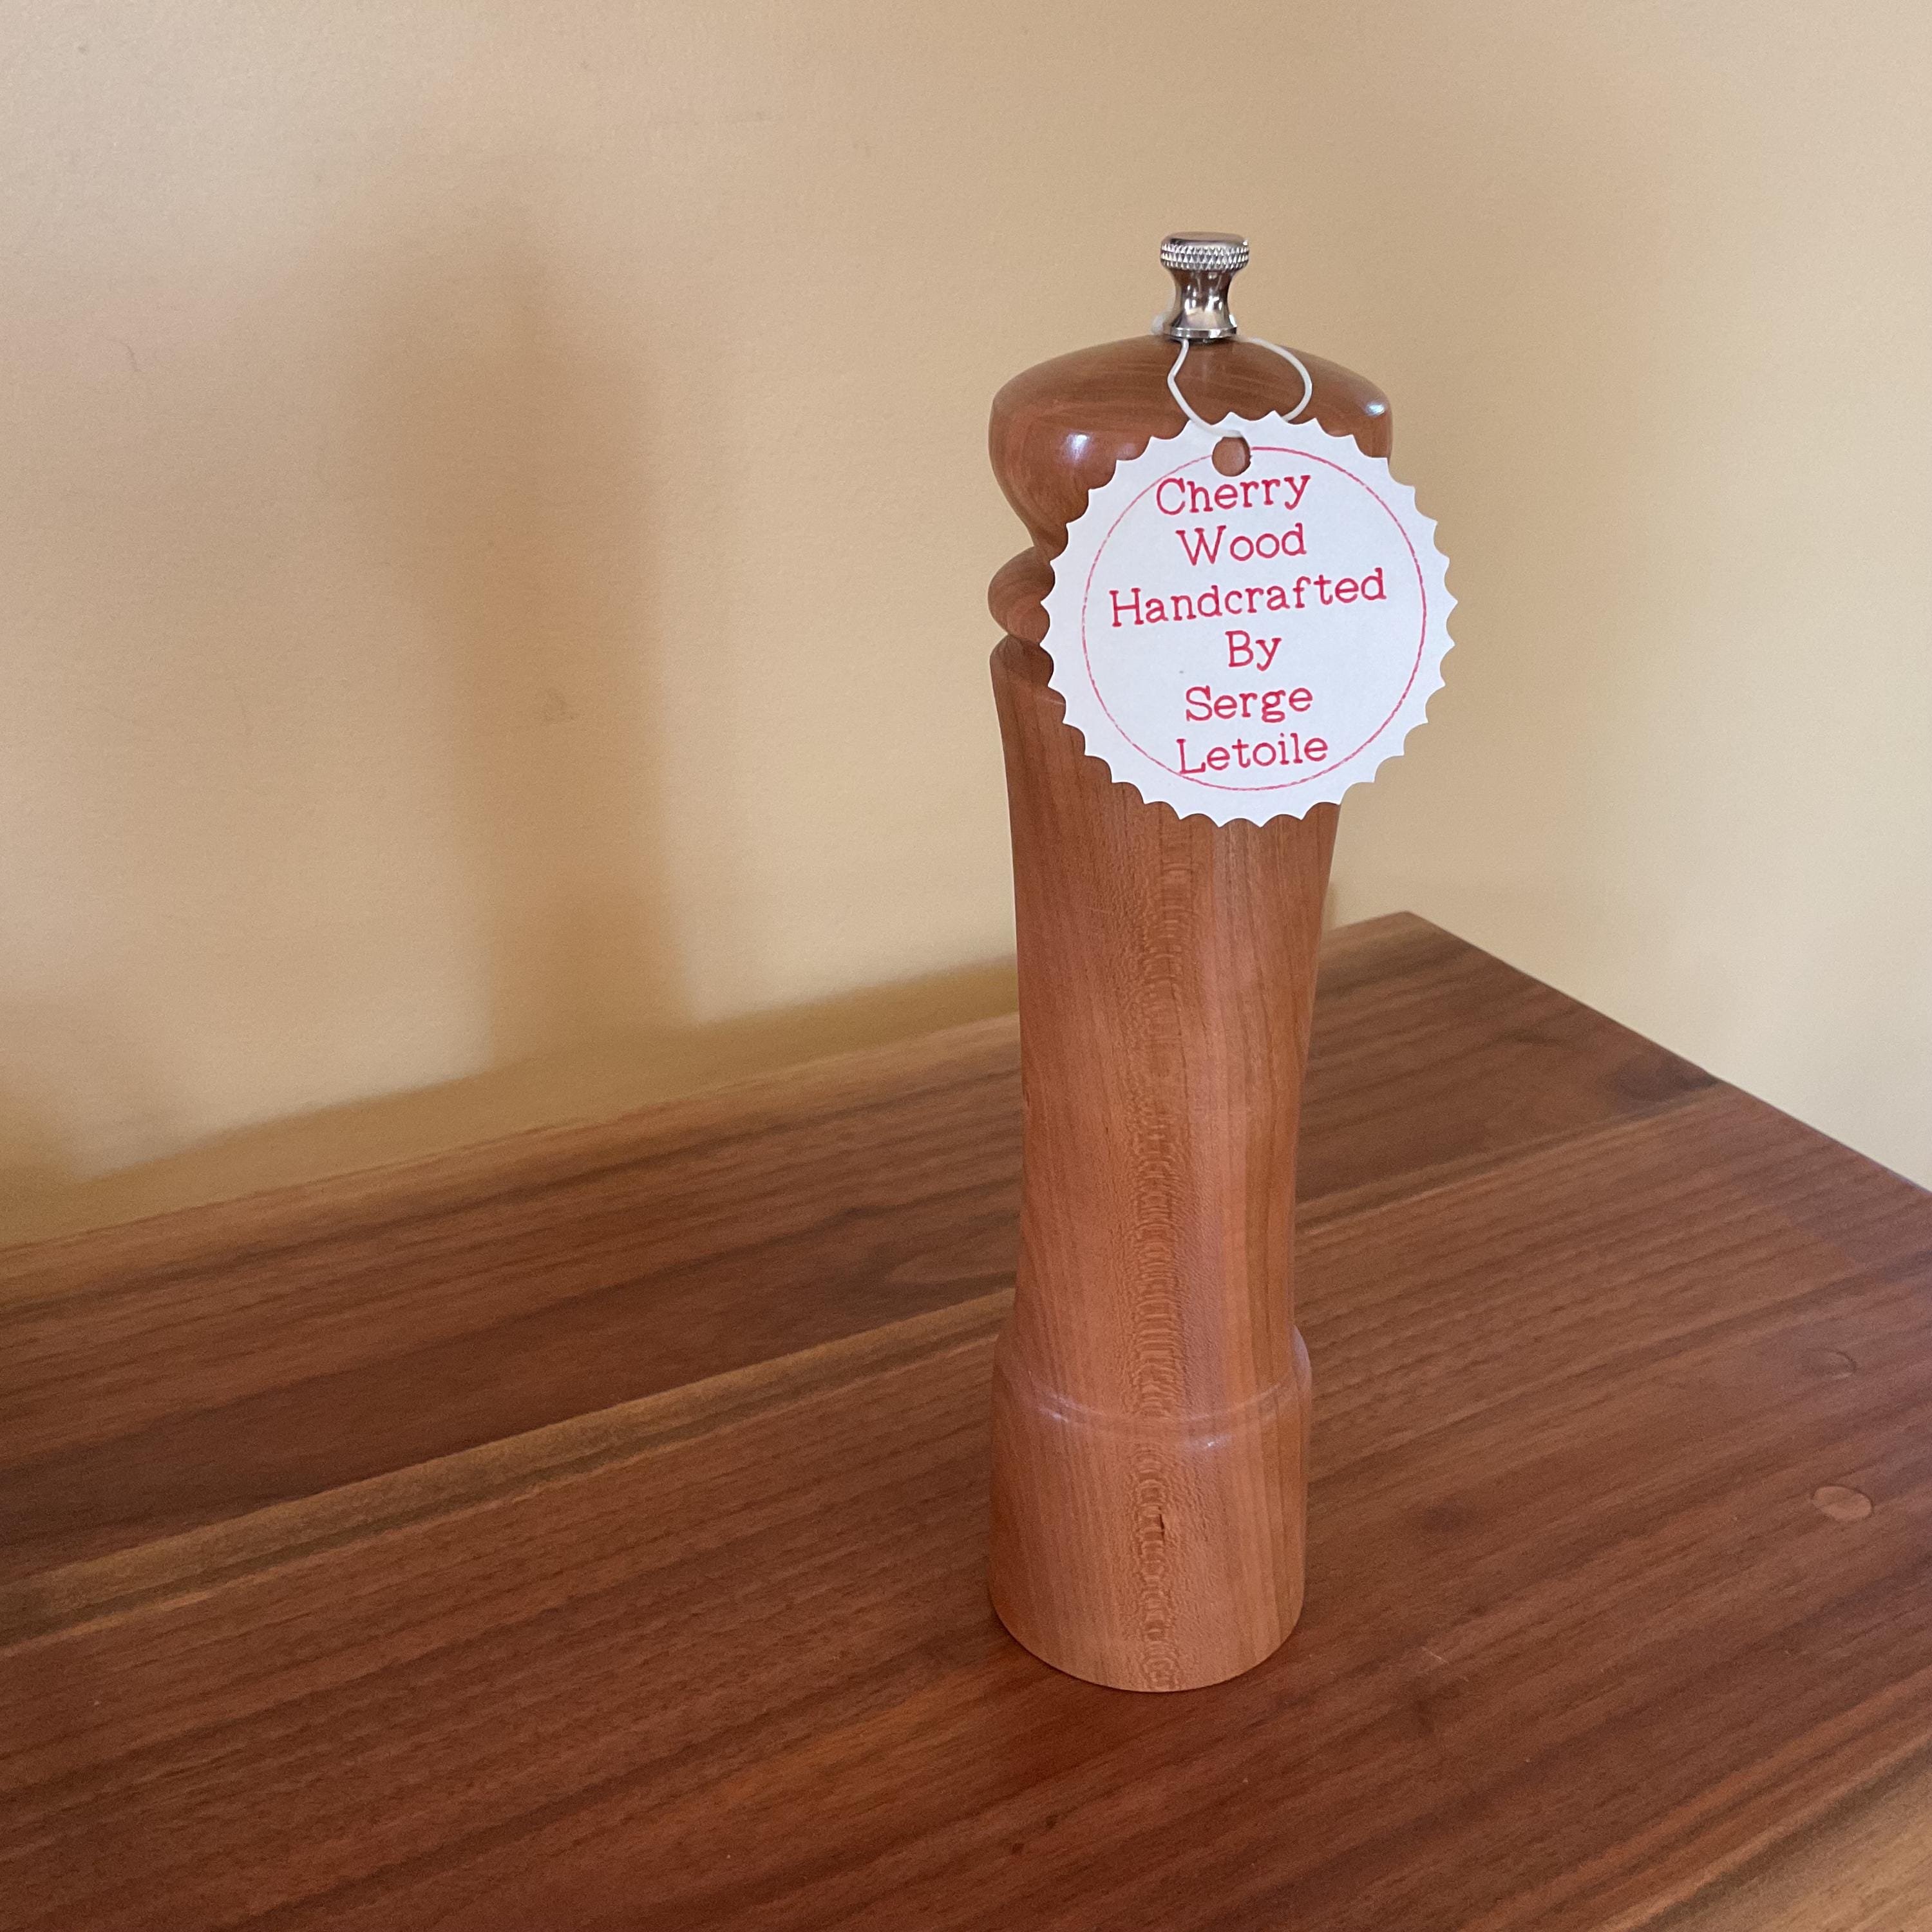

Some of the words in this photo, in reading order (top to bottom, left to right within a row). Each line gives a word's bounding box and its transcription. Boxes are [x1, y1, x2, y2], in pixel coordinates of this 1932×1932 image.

[1155, 474, 1311, 516] Cherry
[1175, 522, 1307, 567] Wood
[1109, 567, 1387, 629] Handcrafted
[1225, 629, 1282, 672] By
[1185, 685, 1314, 723] Serge
[1176, 732, 1329, 775] Letoile
